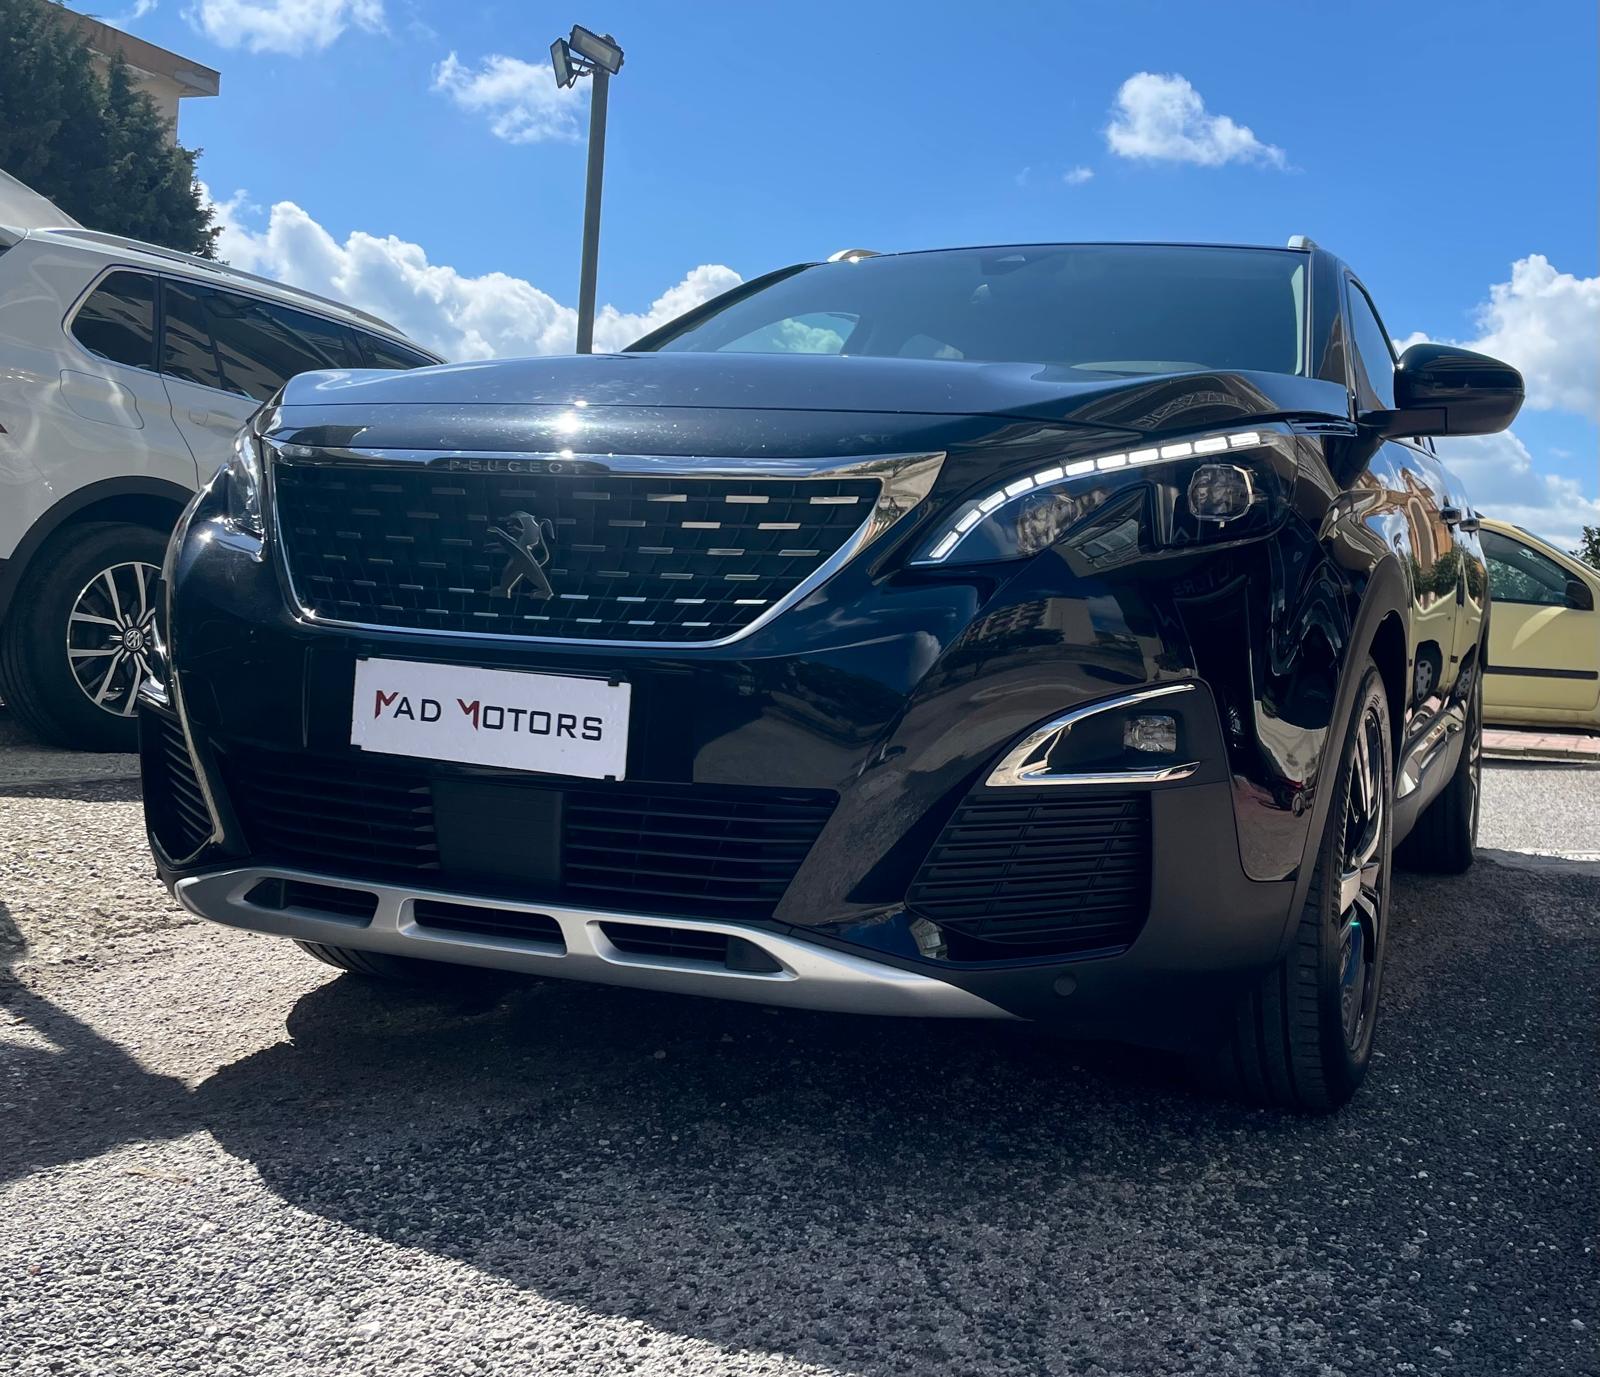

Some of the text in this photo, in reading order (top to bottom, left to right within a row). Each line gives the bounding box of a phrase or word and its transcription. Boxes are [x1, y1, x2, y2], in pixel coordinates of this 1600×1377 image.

[449, 460, 585, 474] PEUGEOT
[374, 690, 604, 742] MAD MOTORS
